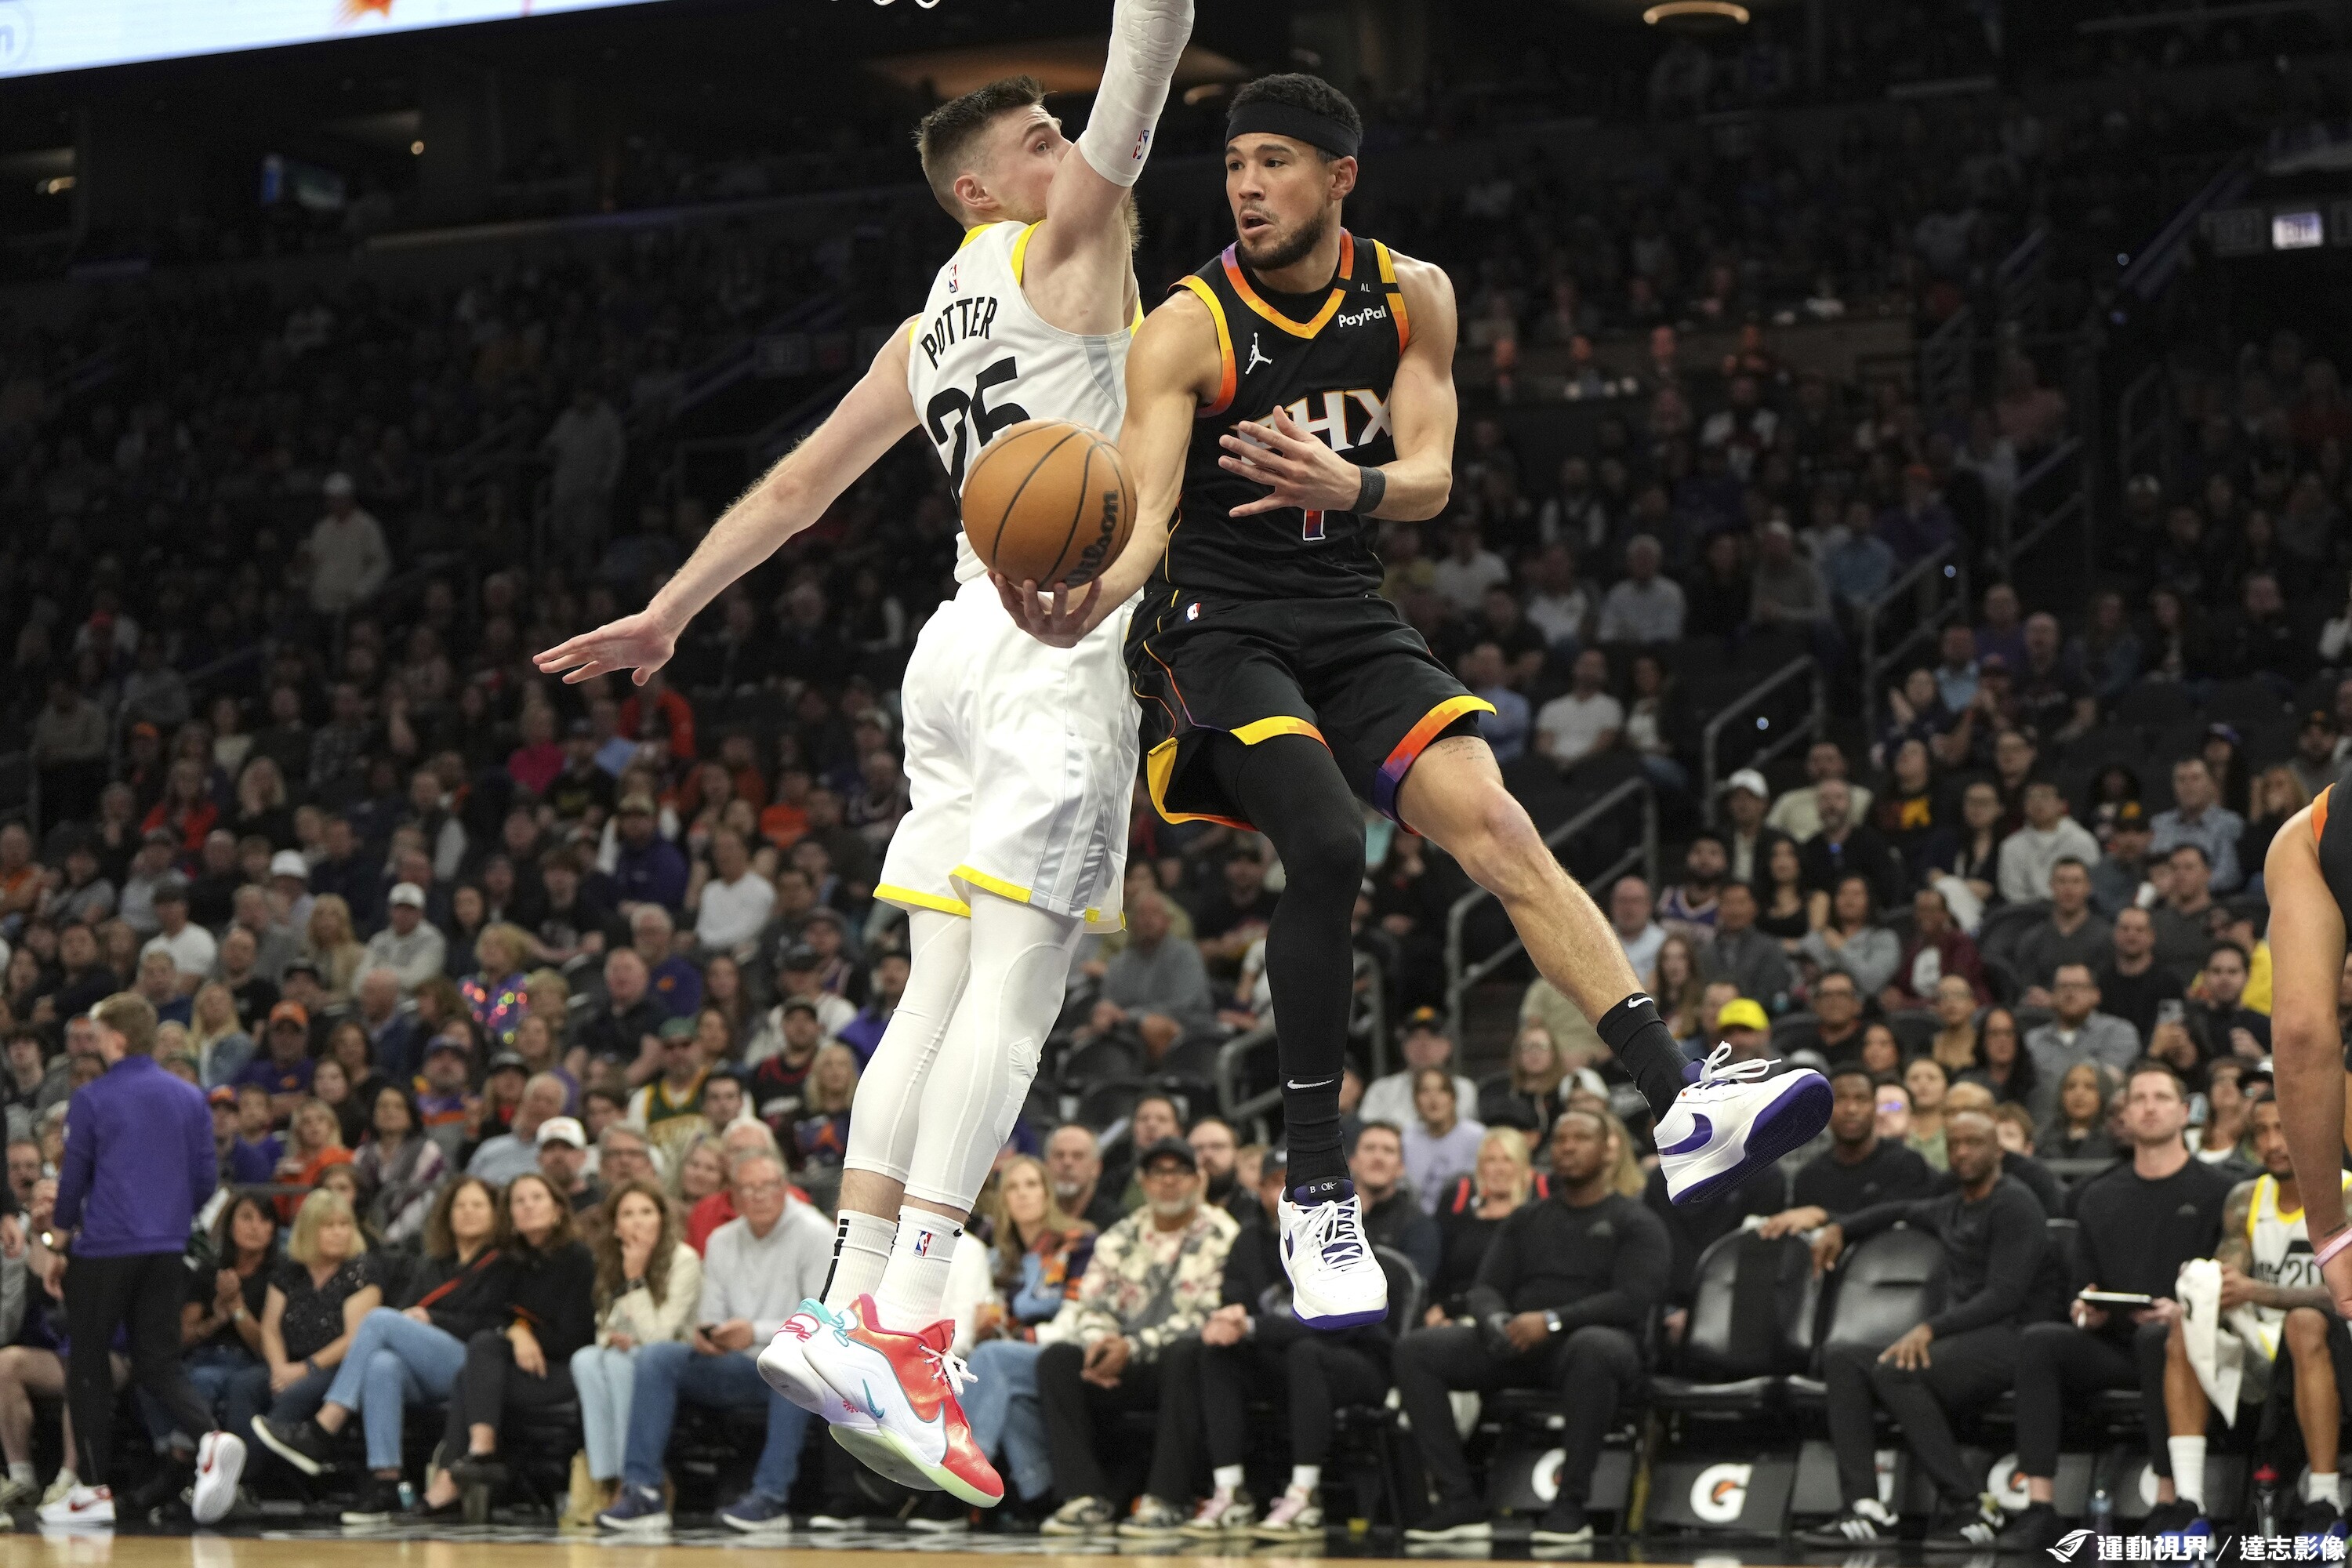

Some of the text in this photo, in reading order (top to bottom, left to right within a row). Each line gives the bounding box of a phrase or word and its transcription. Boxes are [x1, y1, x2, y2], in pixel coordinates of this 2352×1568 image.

[1360, 282, 1371, 292] AL
[920, 296, 998, 371] POTTER
[1338, 304, 1387, 328] PayPal
[1690, 1462, 1753, 1523] G
